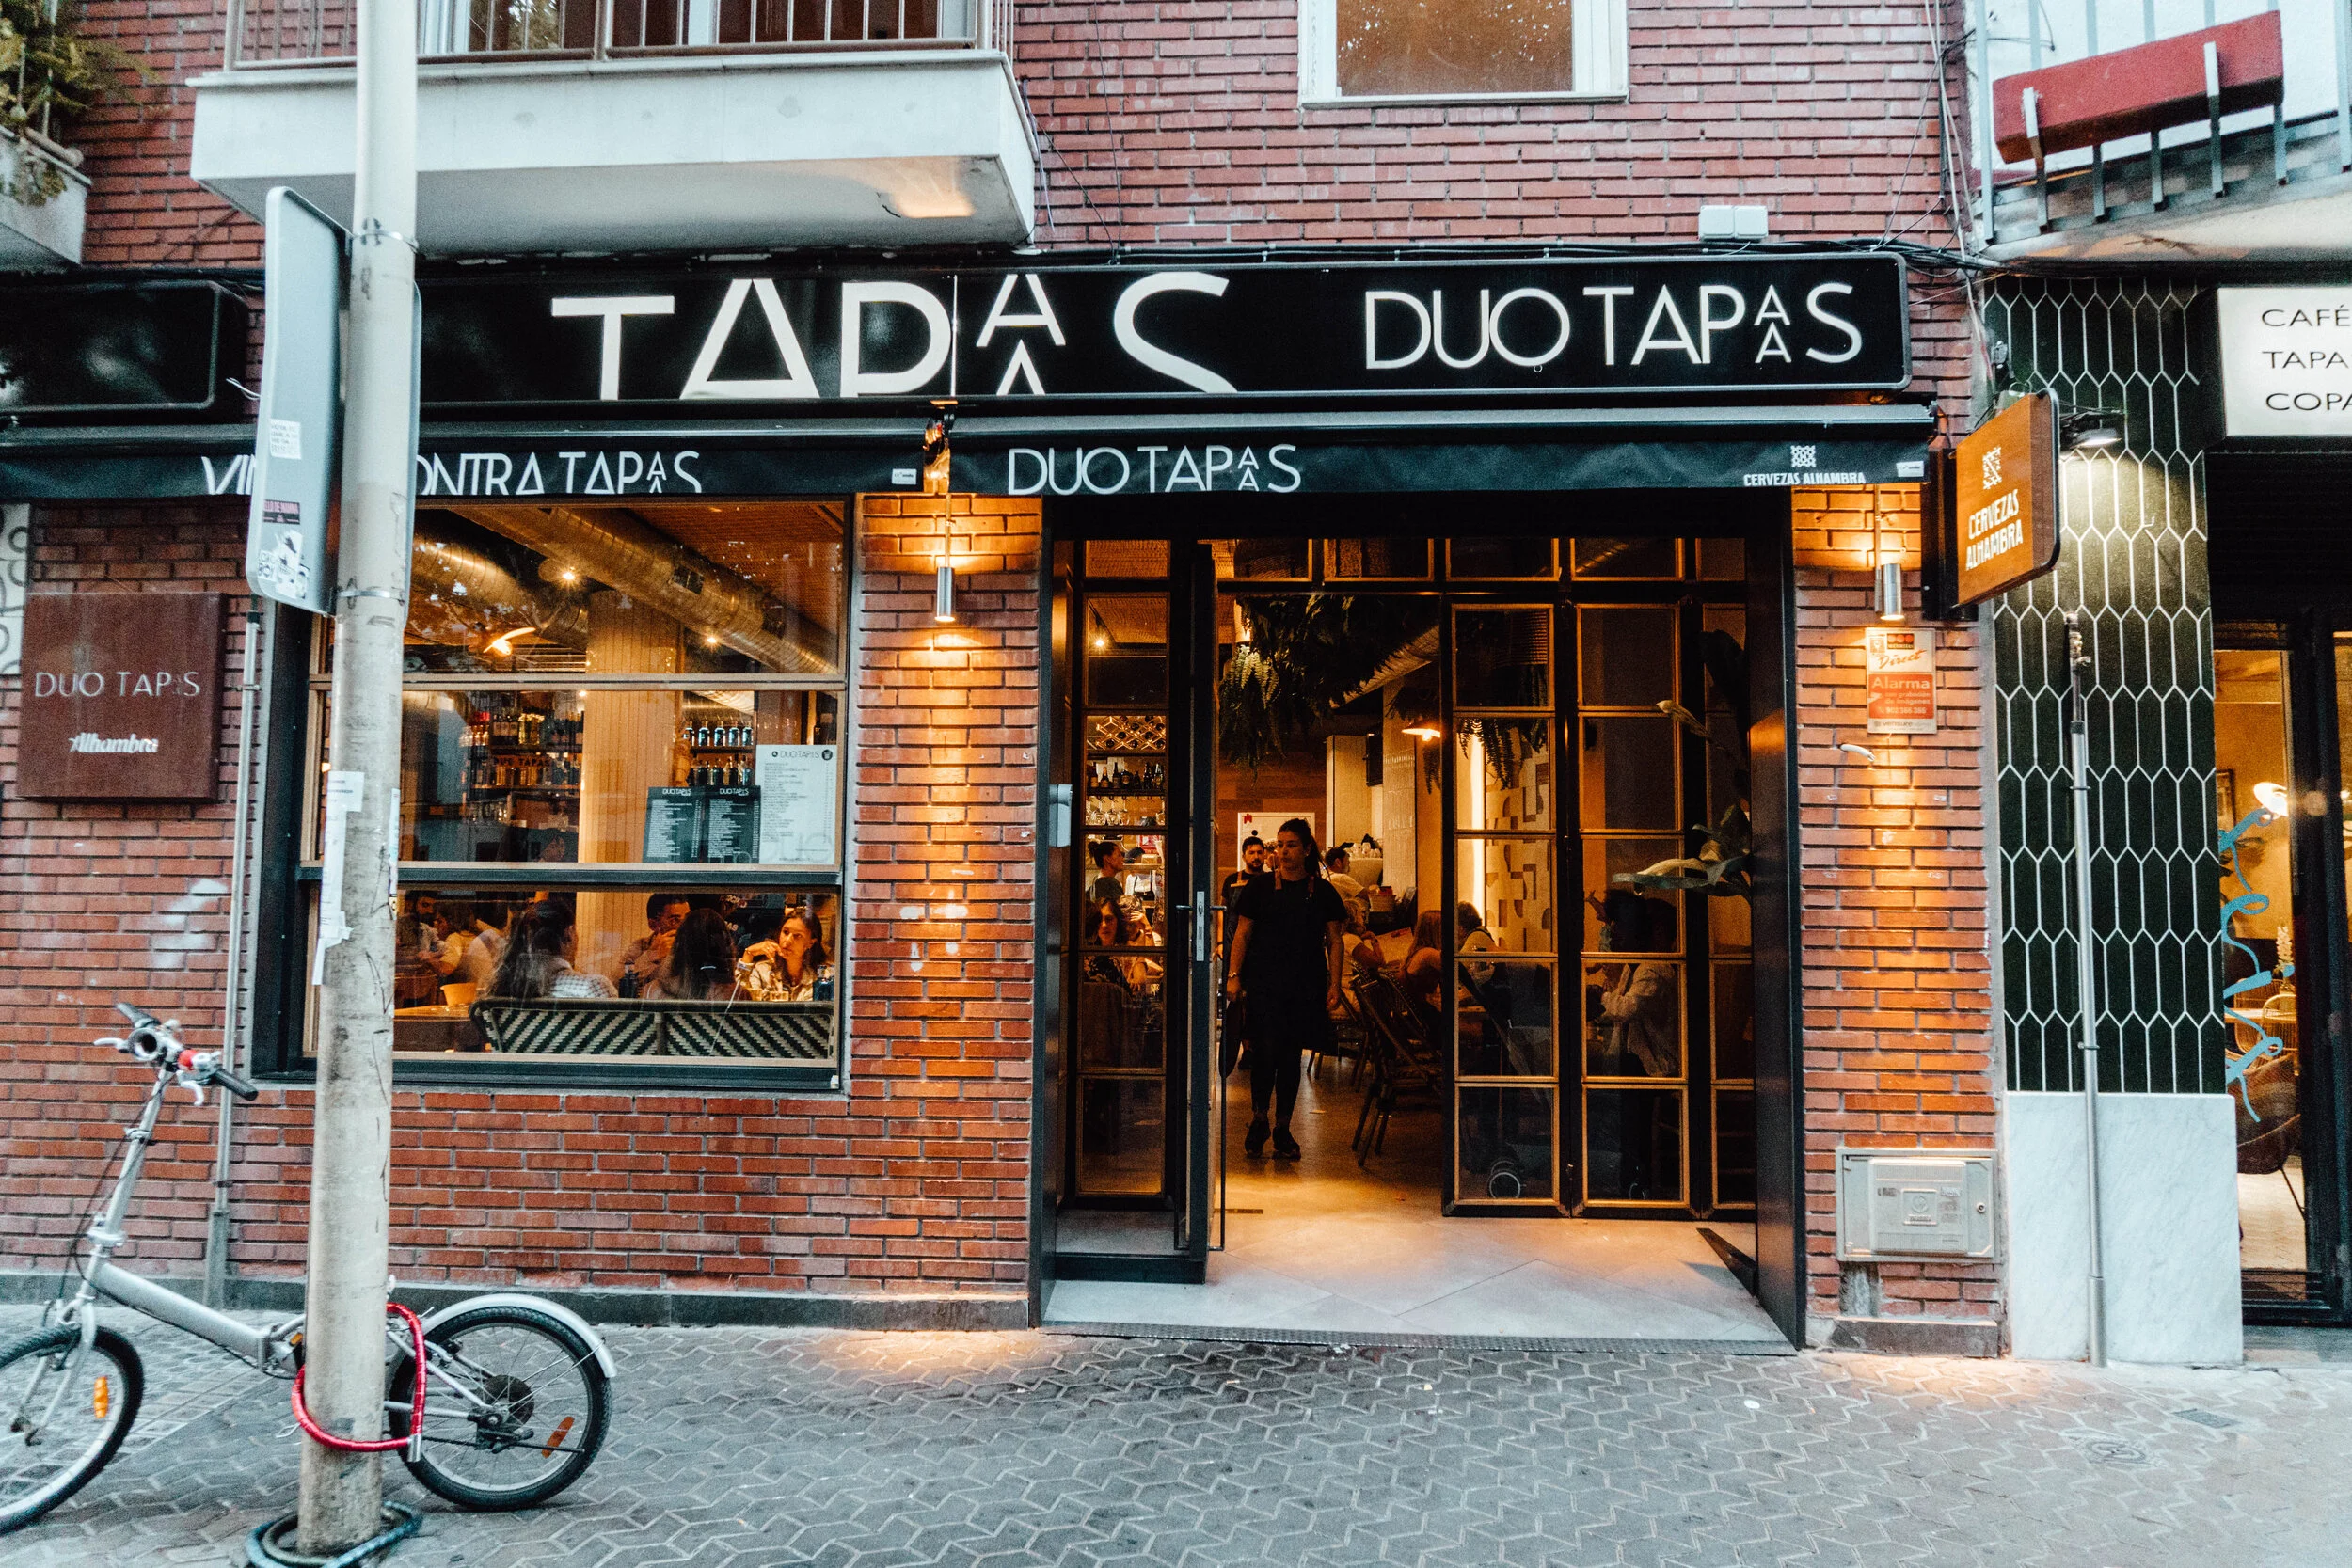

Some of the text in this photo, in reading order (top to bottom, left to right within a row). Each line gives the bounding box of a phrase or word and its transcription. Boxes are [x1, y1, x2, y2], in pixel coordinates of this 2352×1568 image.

[1365, 283, 1863, 369] DUO TAPAS
[2262, 304, 2351, 327] CAFÉ
[2262, 351, 2352, 370] TAPA
[558, 450, 703, 495] TAPAS
[1008, 443, 1301, 496] DUO TAPAS
[1743, 471, 1867, 487] CERVEZAS ALHAMBRA
[1968, 488, 2020, 540] CERVEZAS
[1965, 518, 2024, 571] ALHAMBRA
[1878, 649, 1928, 670] Direct
[35, 671, 105, 698] DUO
[1872, 676, 1931, 689] Alarma
[68, 732, 159, 753] Alhambra
